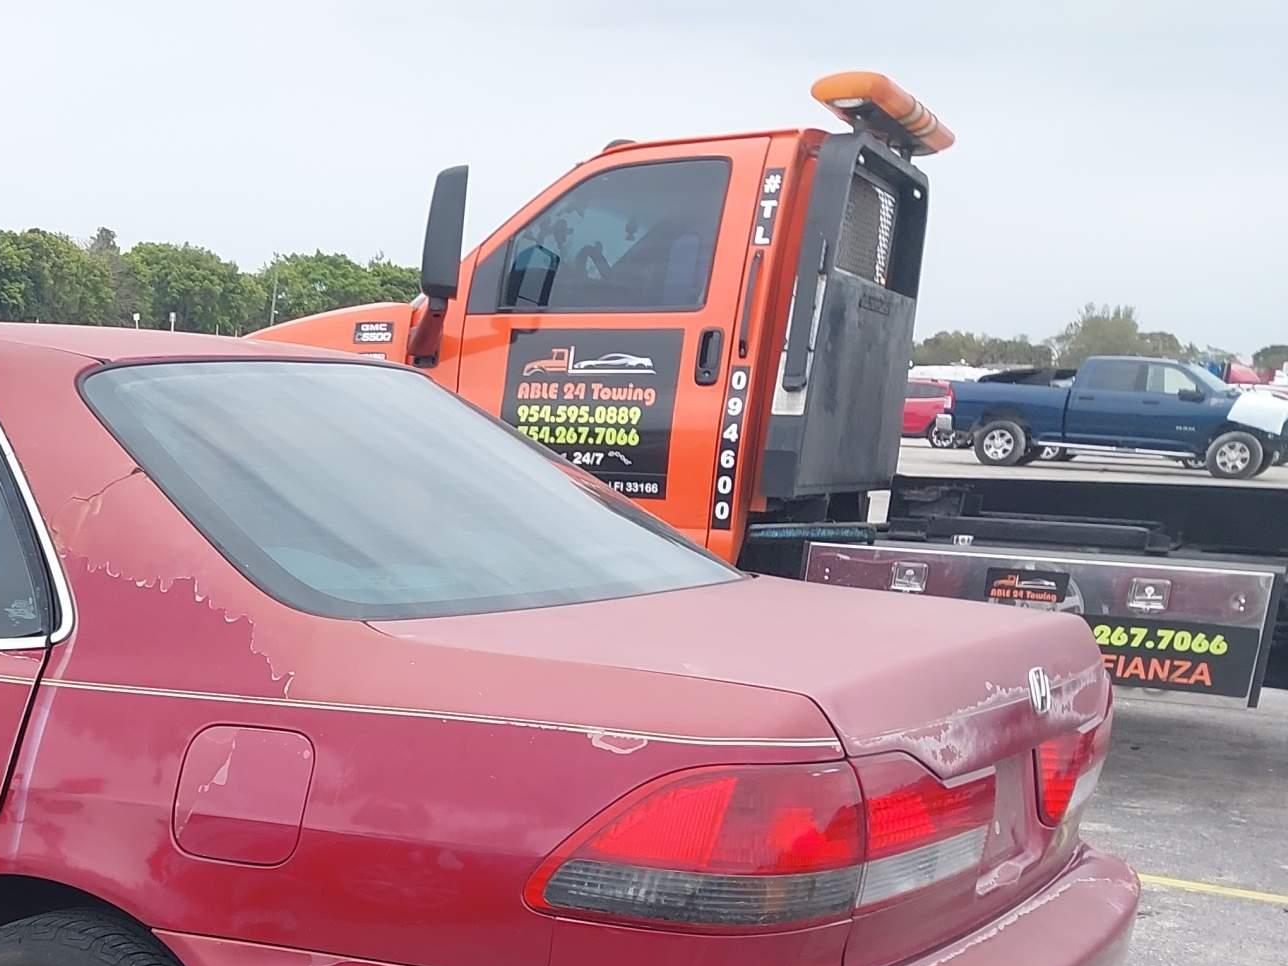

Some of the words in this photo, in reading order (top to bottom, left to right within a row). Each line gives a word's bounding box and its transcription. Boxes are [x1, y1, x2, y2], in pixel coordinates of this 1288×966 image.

[360, 323, 388, 331] GMC
[517, 382, 559, 400] ABLE
[563, 383, 586, 400] 24
[591, 383, 656, 406] Towing
[517, 405, 642, 425] 954.595.0889
[714, 371, 747, 520] 094600
[572, 452, 605, 465] 24/7
[625, 482, 659, 493] 33166
